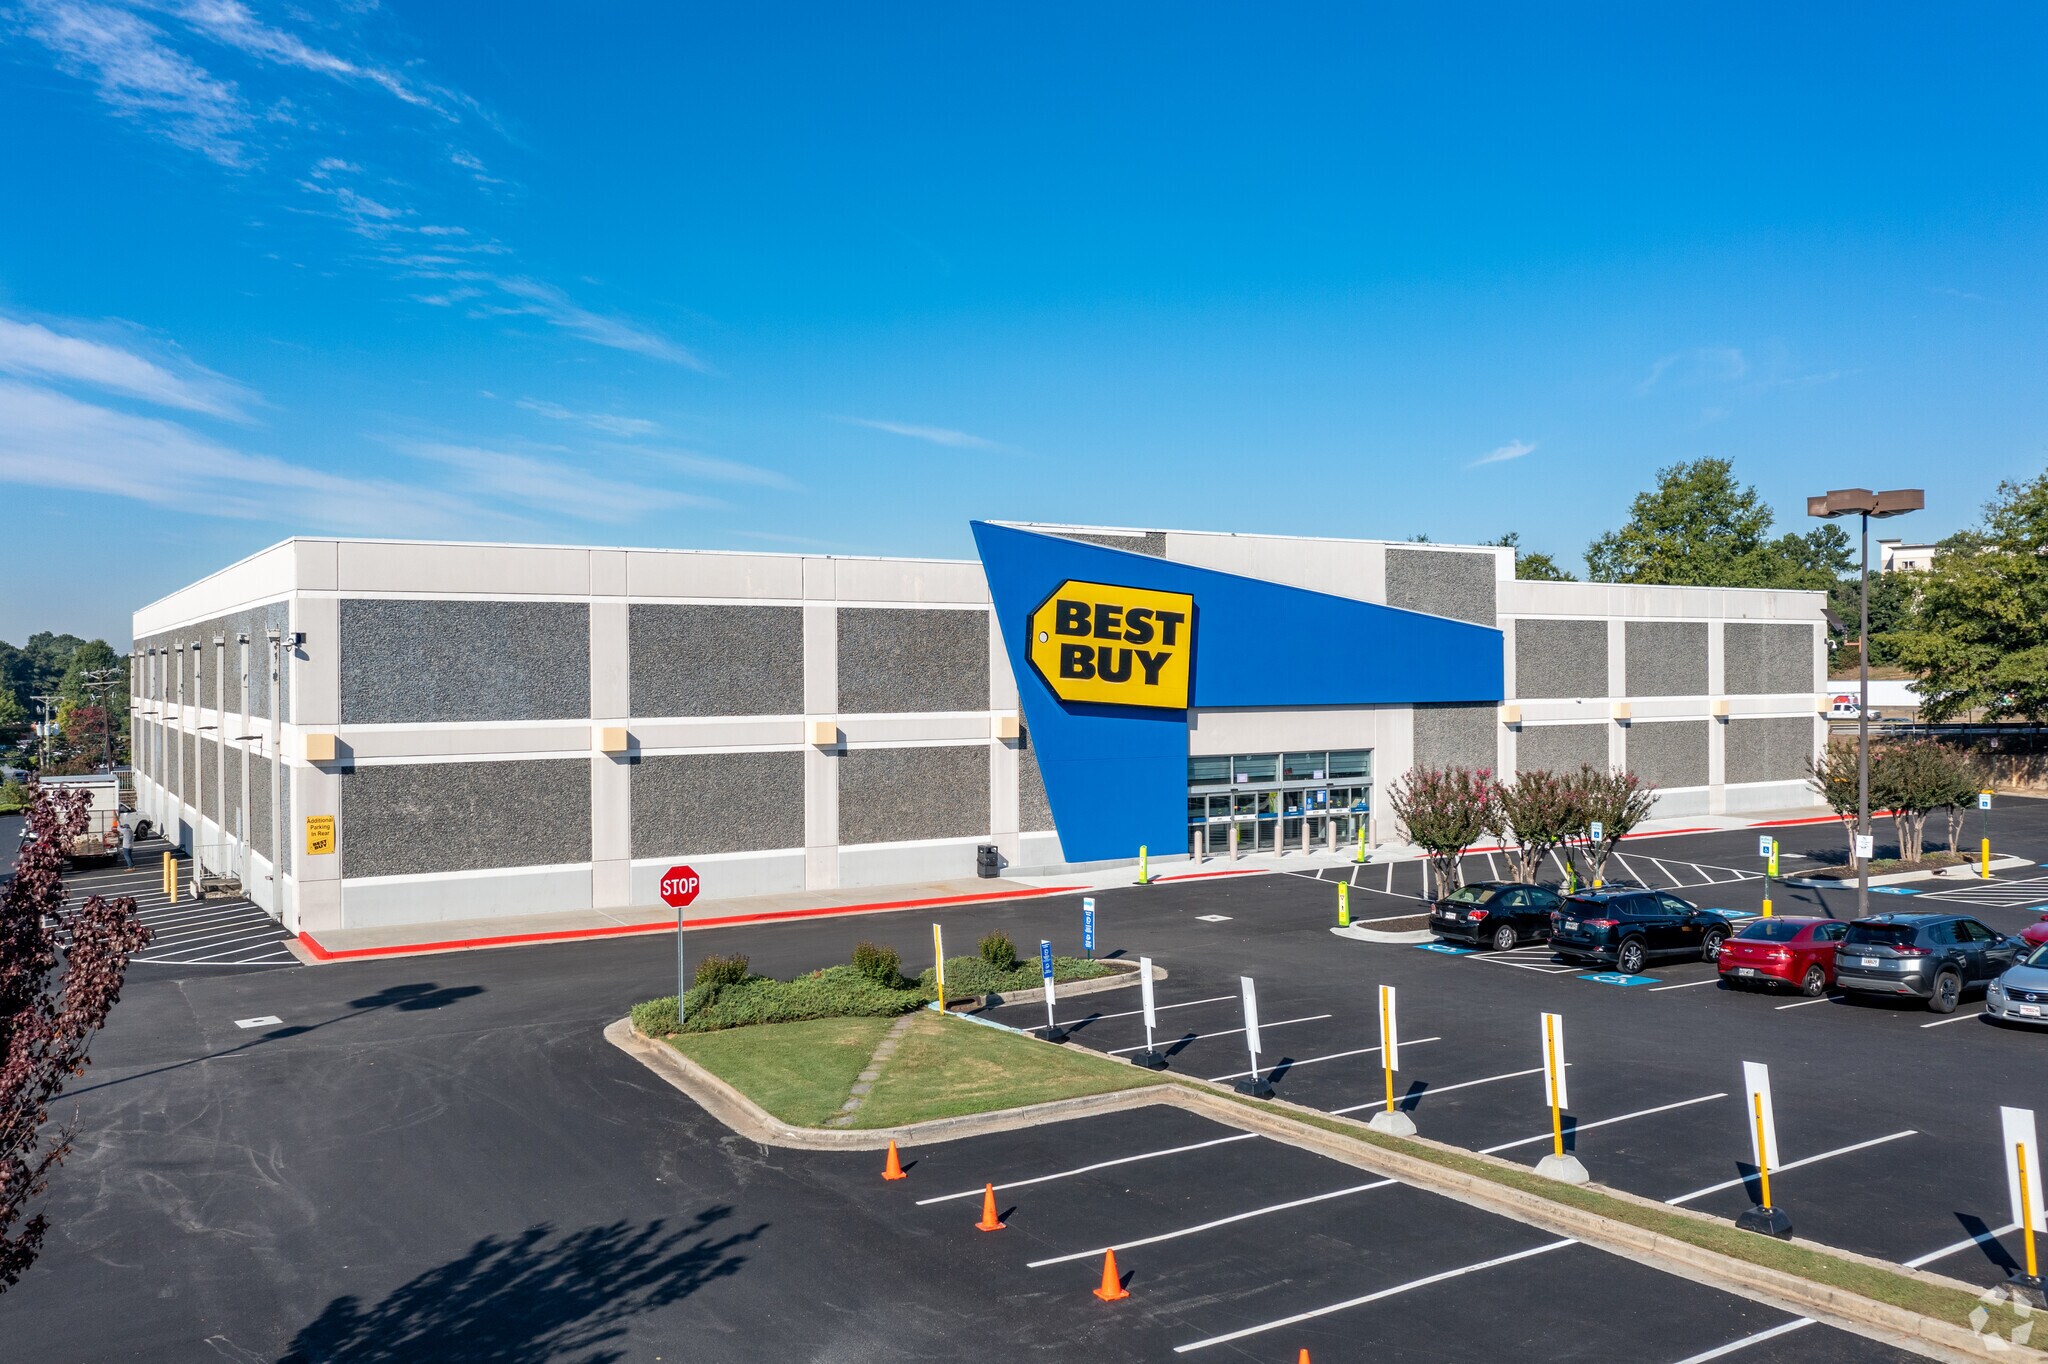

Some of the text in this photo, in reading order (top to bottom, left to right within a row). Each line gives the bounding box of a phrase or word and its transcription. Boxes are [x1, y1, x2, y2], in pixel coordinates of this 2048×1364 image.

[1055, 599, 1185, 646] BEST
[1060, 643, 1173, 686] BUY
[662, 877, 698, 896] STOP
